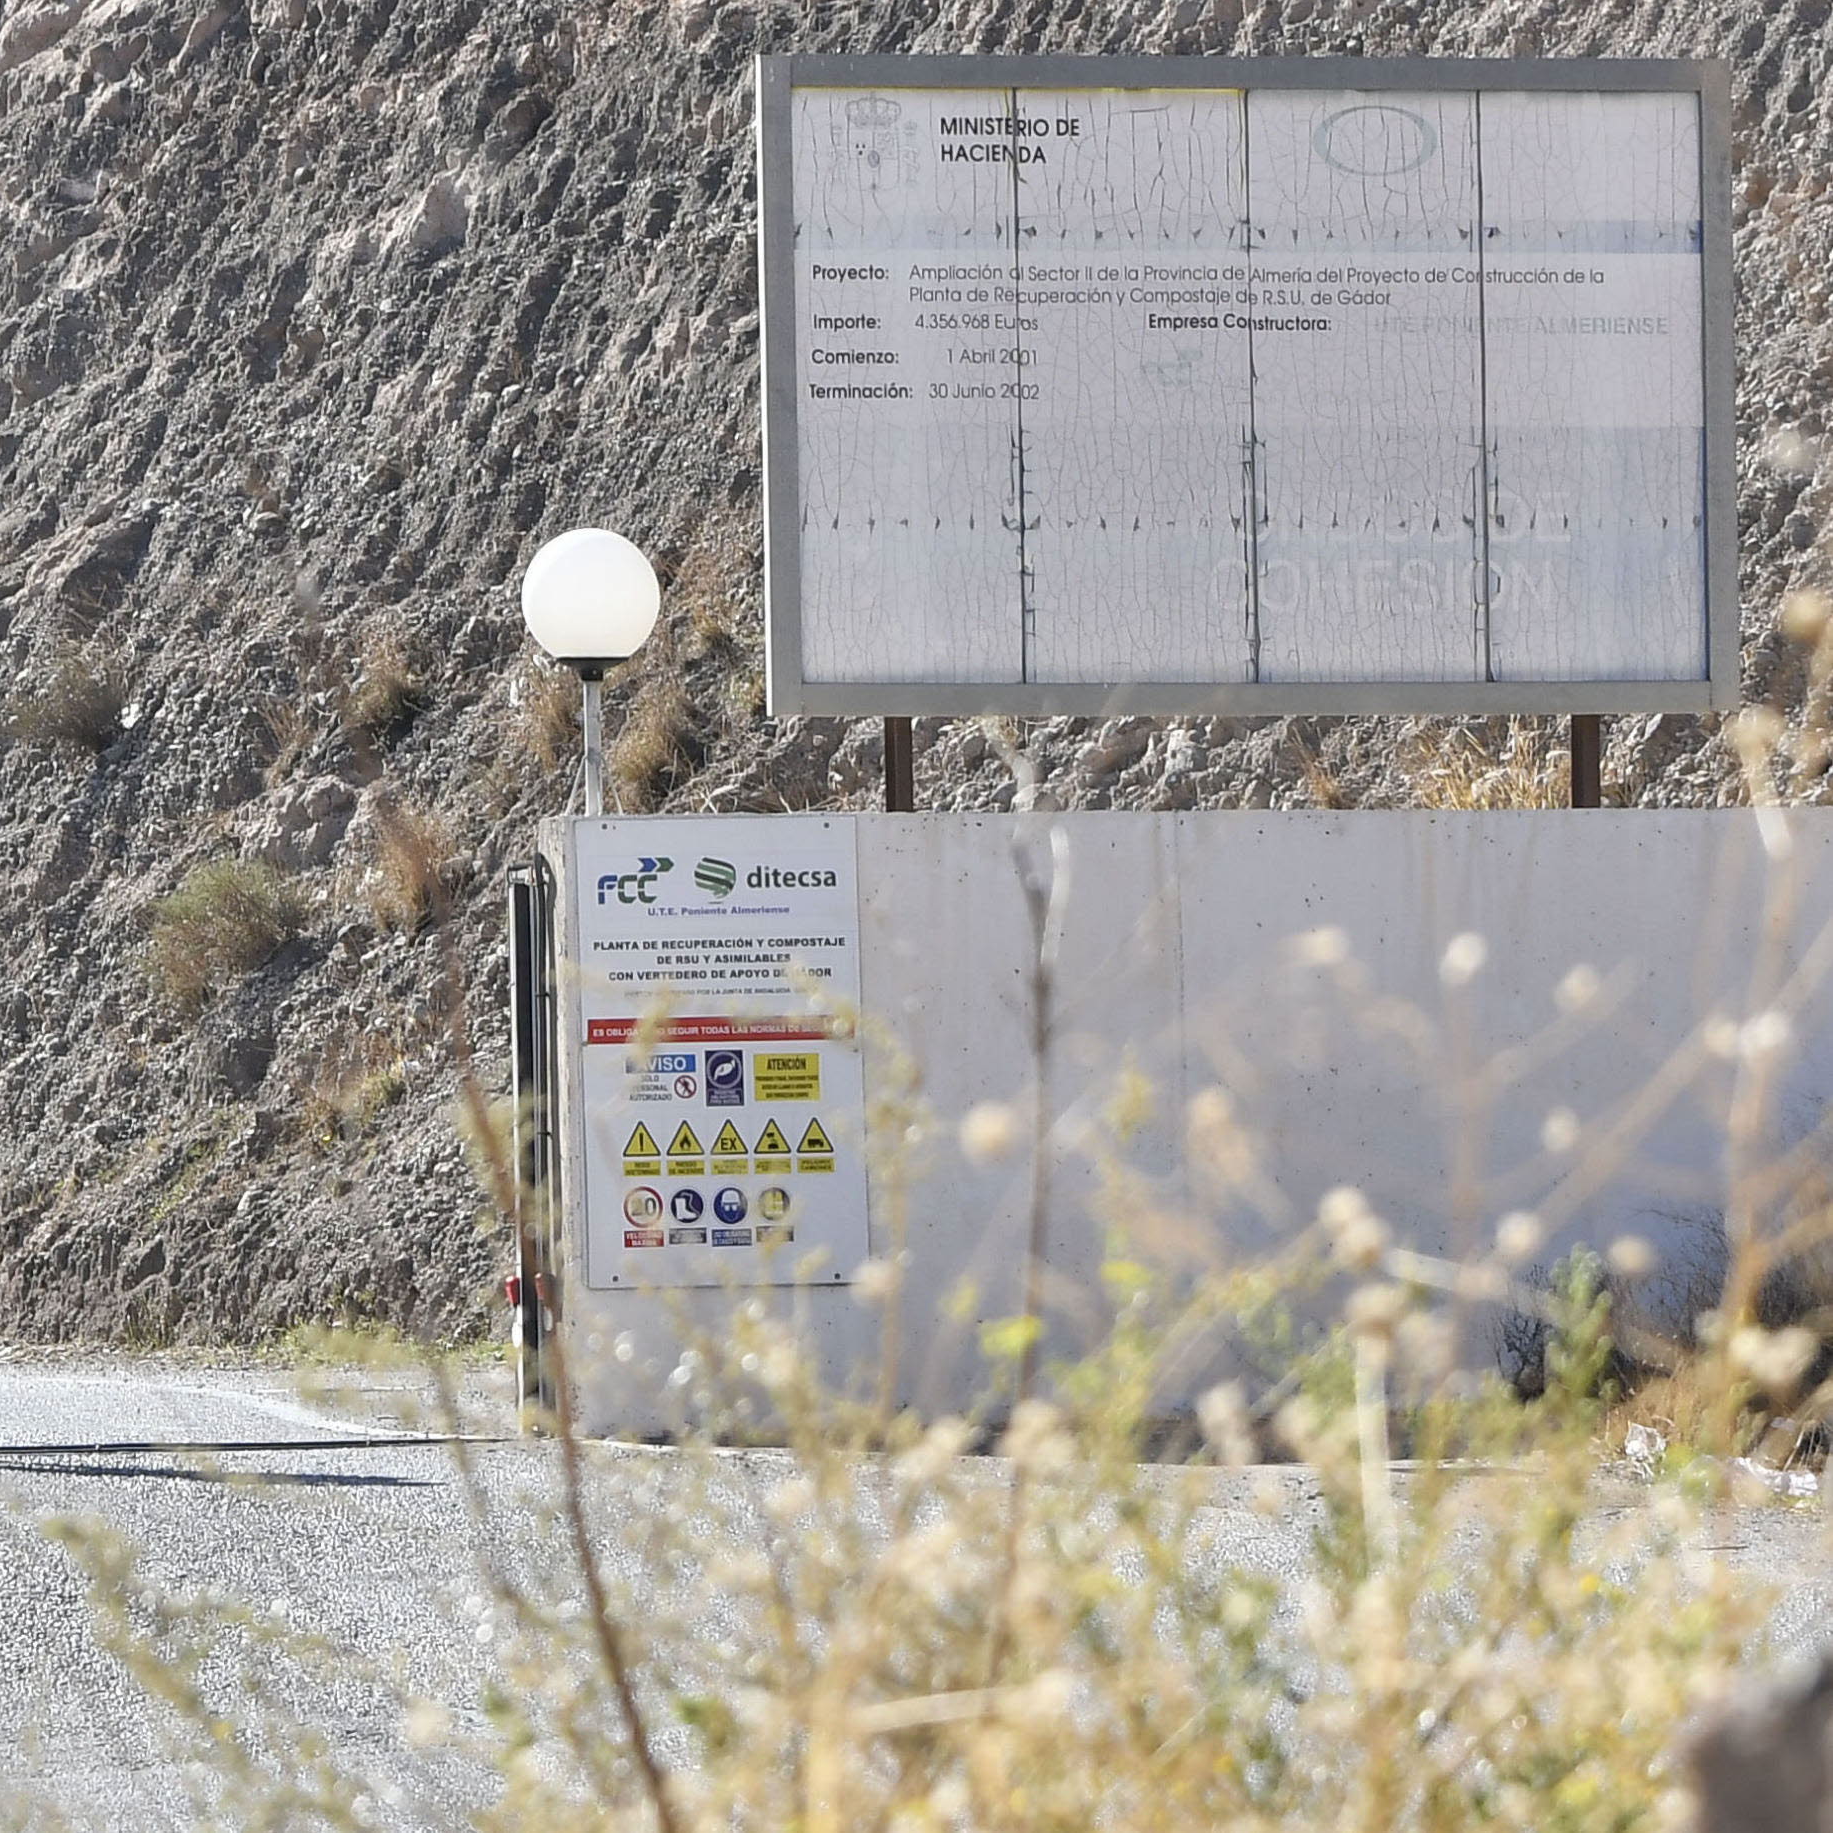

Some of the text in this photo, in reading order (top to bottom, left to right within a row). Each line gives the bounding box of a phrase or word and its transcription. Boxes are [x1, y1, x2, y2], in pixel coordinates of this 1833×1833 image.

[940, 117, 1081, 137] MINISTERIO DE
[940, 144, 1047, 164] HACIENDA
[812, 265, 889, 283] Proyecto:
[909, 263, 1003, 283] Ampliación
[1028, 266, 1081, 282] Sector
[1097, 265, 1120, 281] de
[1124, 265, 1139, 281] la
[1144, 265, 1218, 282] Provincia
[1222, 265, 1245, 281] de
[1250, 266, 1312, 284] Almería
[1316, 266, 1342, 284] del
[1346, 268, 1420, 288] Proyecto
[1424, 268, 1447, 284] de
[1451, 266, 1559, 285] Construcción
[1563, 268, 1586, 285] de
[1589, 268, 1604, 285] la
[909, 286, 1391, 308] Planta de Recuperación y Compostaje de R.S.U. de Gádor
[813, 315, 881, 333] Importe:
[915, 314, 1038, 331] 4.356.968 Euros
[1149, 314, 1332, 332] Empresa Constructora:
[1534, 316, 1669, 335] ALMERIENSE
[812, 349, 899, 365] Comienzo:
[947, 348, 1038, 365] 1 Abril 2001
[810, 382, 913, 400] Terminación:
[929, 383, 1039, 400] 30 Junio 2002
[746, 866, 837, 888] ditecsa
[598, 873, 658, 905] FCC
[647, 906, 790, 917] U.T.E. Poniente Almeriense
[593, 936, 846, 951] PLANTA DE RECUPERACIÓN Y COMPOSTAJE
[656, 953, 791, 965] DE RSU Y ASIMILABLES
[608, 971, 634, 981] CON
[637, 969, 707, 981] VERTEDERO
[711, 969, 726, 979] DE
[729, 968, 769, 979] APOYO
[700, 1025, 729, 1035] TODAS
[638, 1056, 687, 1072] VISO
[767, 1056, 806, 1071] ATENCIÓN
[720, 1137, 737, 1151] EX
